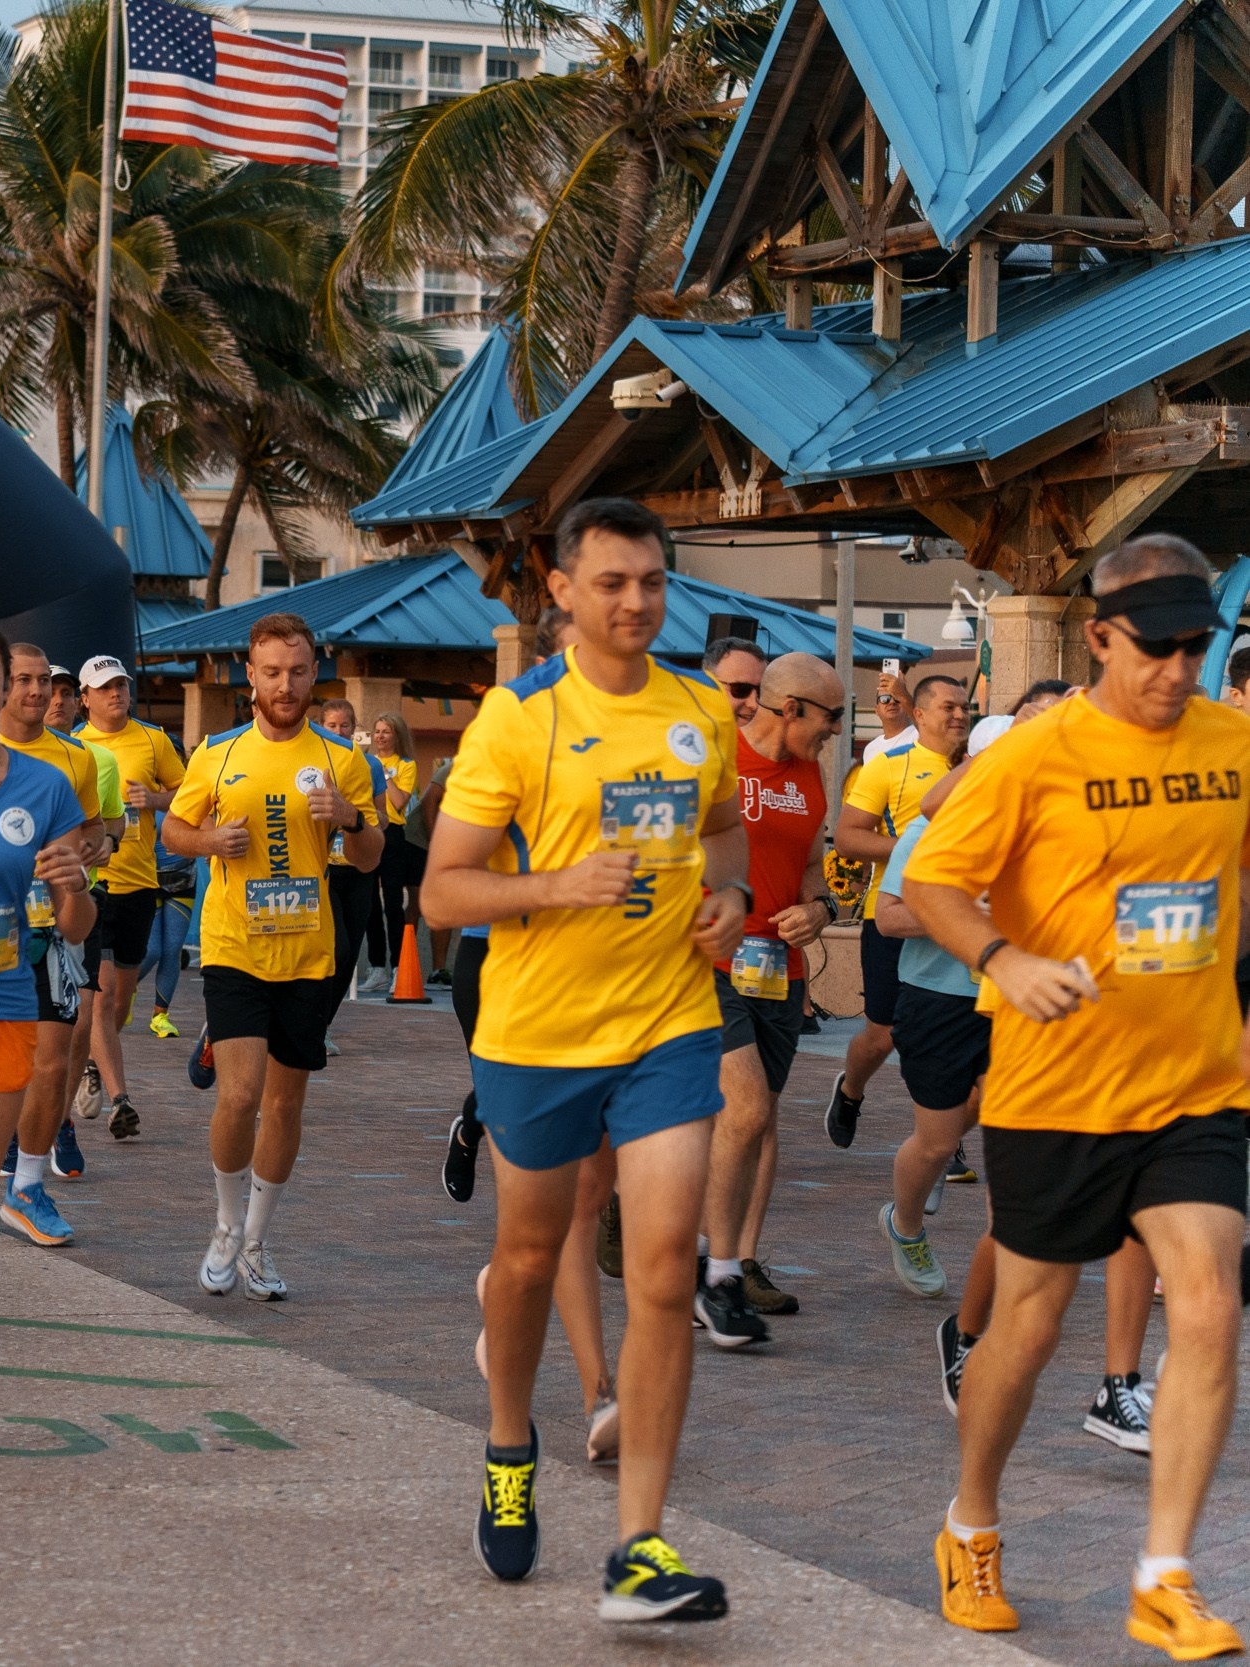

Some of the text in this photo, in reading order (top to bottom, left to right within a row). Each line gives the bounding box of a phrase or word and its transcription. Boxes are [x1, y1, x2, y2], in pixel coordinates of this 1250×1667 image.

[1085, 770, 1241, 812] OLD GRAD
[632, 802, 674, 839] 23
[252, 881, 279, 889] RAZOM
[264, 890, 301, 916] 112
[1147, 904, 1203, 943] 177
[757, 952, 776, 979] 76
